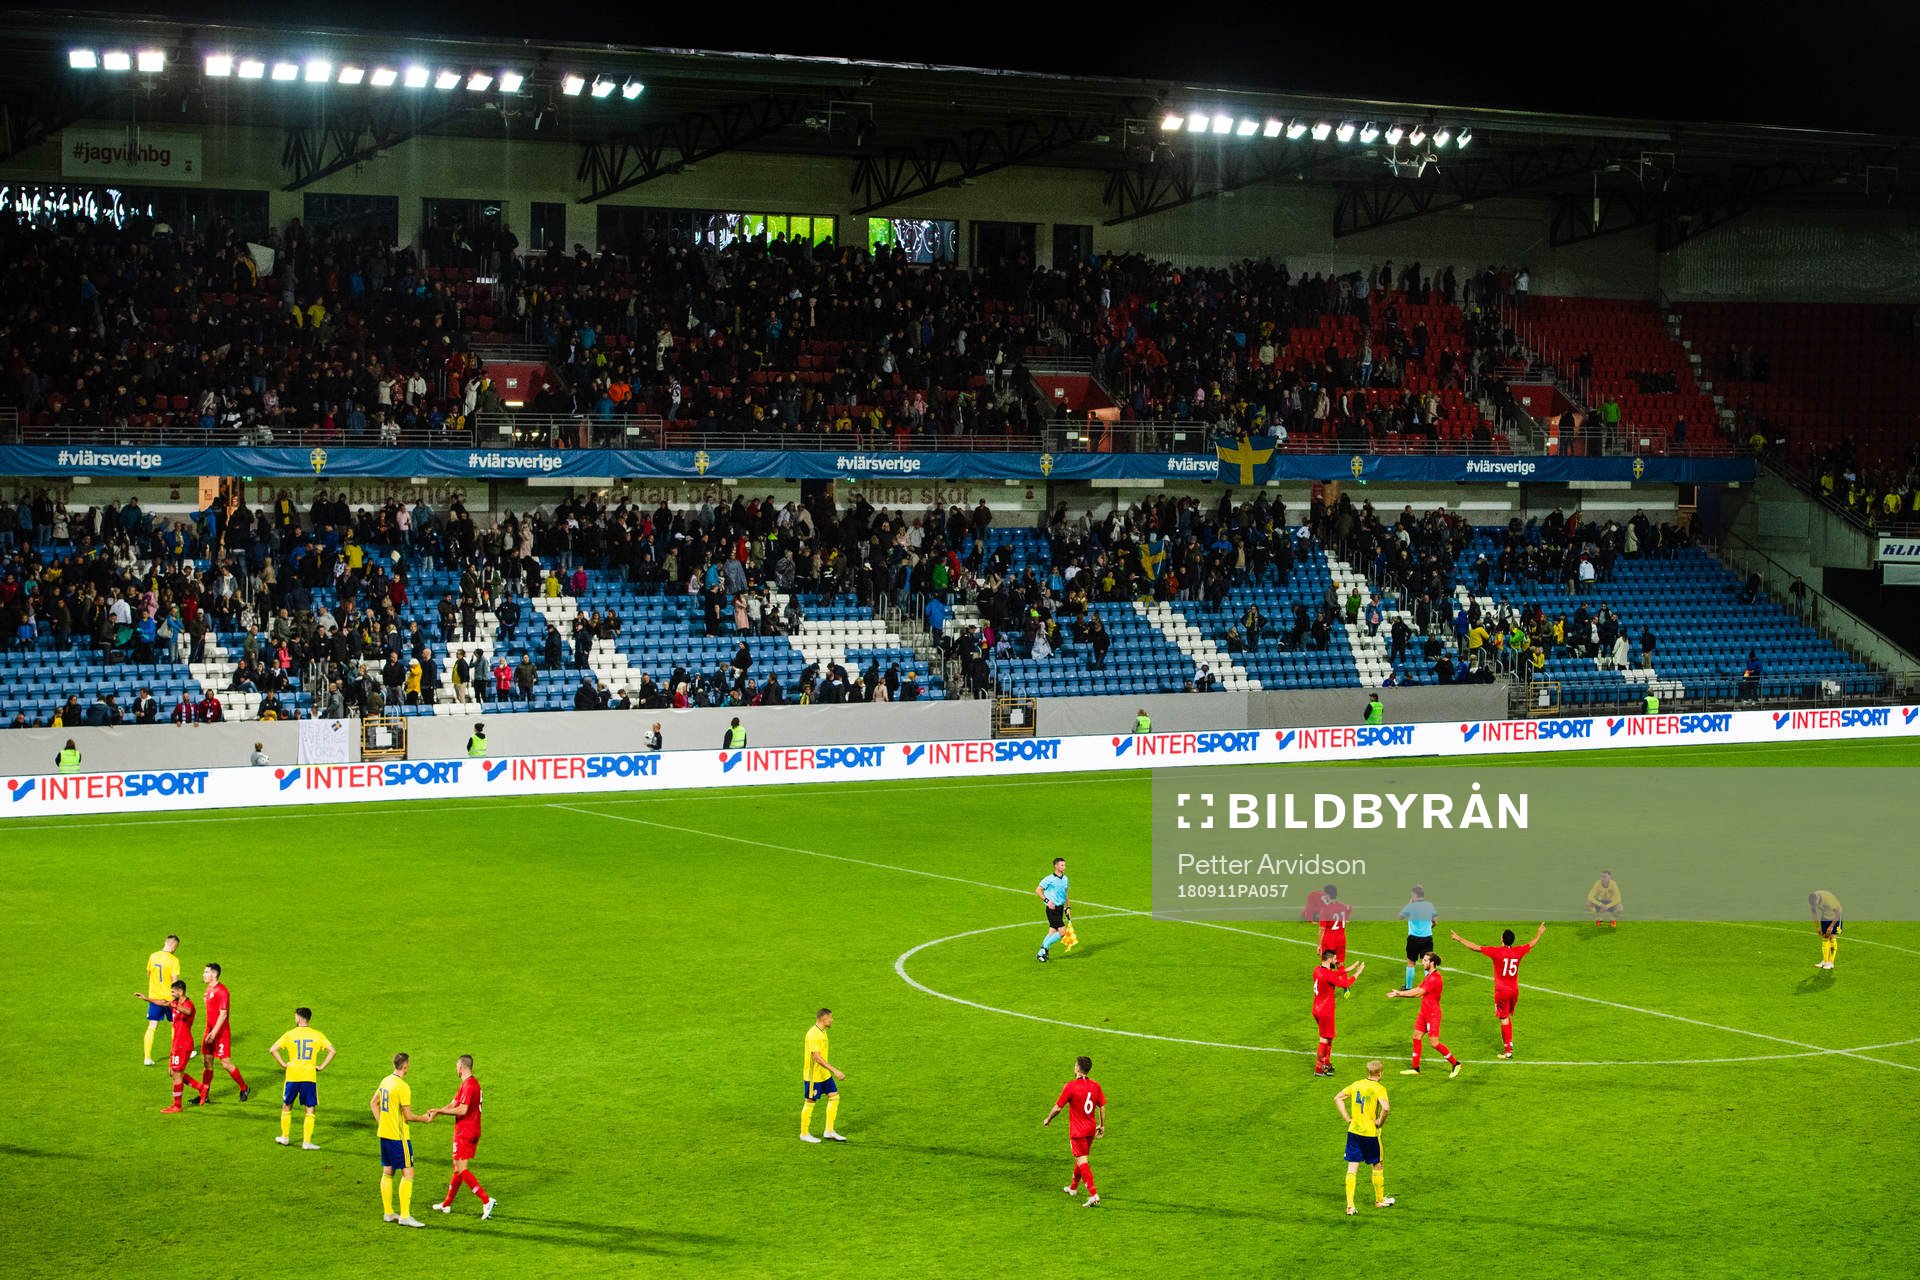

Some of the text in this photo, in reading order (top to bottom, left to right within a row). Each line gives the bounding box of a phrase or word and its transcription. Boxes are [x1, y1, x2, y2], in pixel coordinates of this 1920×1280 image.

[58, 450, 162, 470] #viärsverige
[468, 453, 562, 472] #viärsverige
[836, 455, 921, 474] #viärsverige
[1466, 459, 1536, 476] #viärsverige
[1628, 714, 1732, 736] INTERSPORT
[1793, 708, 1891, 730] INTERSPORT
[1299, 726, 1415, 749] INTERSPORT
[1482, 719, 1593, 742] INTERSPORT
[930, 740, 1061, 764] INTERSPORT
[1137, 732, 1260, 755] INTERSPORT
[513, 754, 661, 780] INTERSPORT
[747, 746, 885, 771] INTERSPORT
[41, 771, 209, 800] INTERSPORT
[307, 762, 462, 789] INTERSPORT
[1331, 911, 1346, 931] 21
[154, 964, 163, 982] 7
[1502, 958, 1519, 977] 15
[294, 1039, 314, 1061] 16
[1084, 1092, 1094, 1115] 6
[1356, 1091, 1365, 1114] 4
